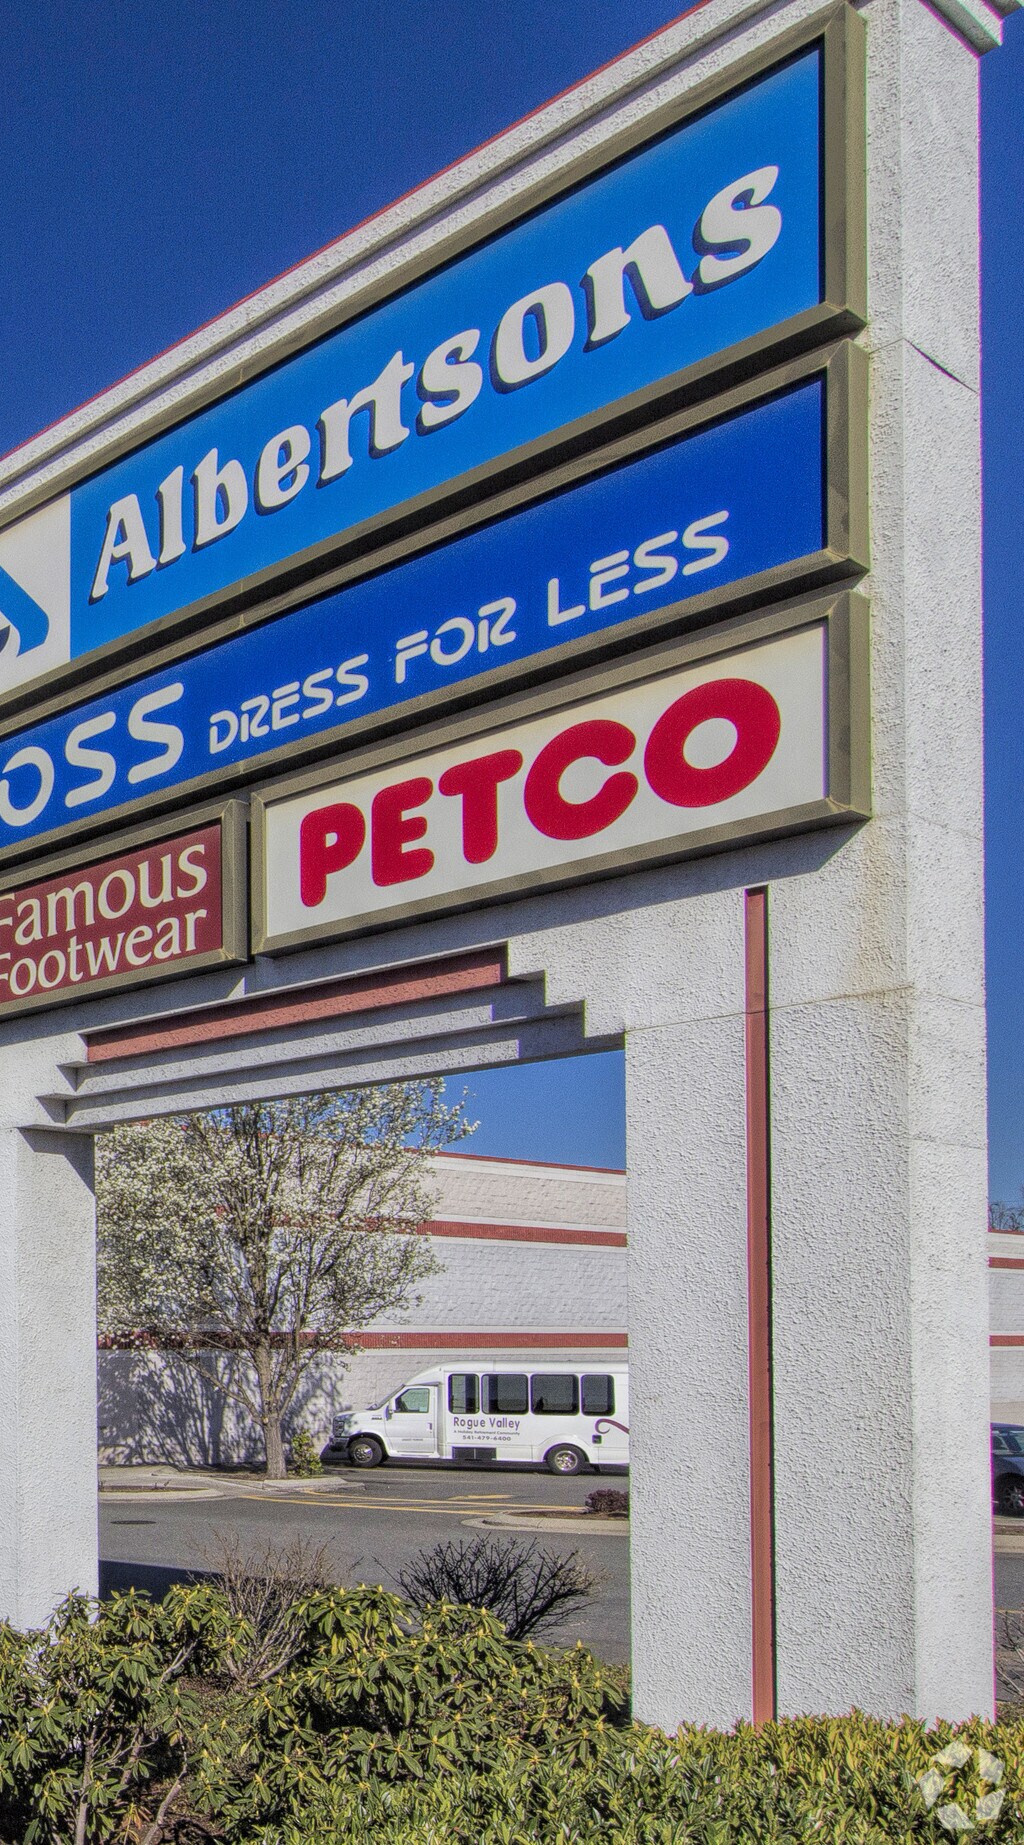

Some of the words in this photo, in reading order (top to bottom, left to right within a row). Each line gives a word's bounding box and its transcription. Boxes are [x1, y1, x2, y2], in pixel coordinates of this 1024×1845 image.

[91, 165, 783, 599] Albertsons
[209, 653, 370, 754] DRESS
[395, 597, 518, 684] FOR
[547, 510, 730, 626] LESS
[300, 680, 780, 907] PETCO
[453, 1416, 486, 1430] Rogue
[489, 1417, 521, 1431] Valley
